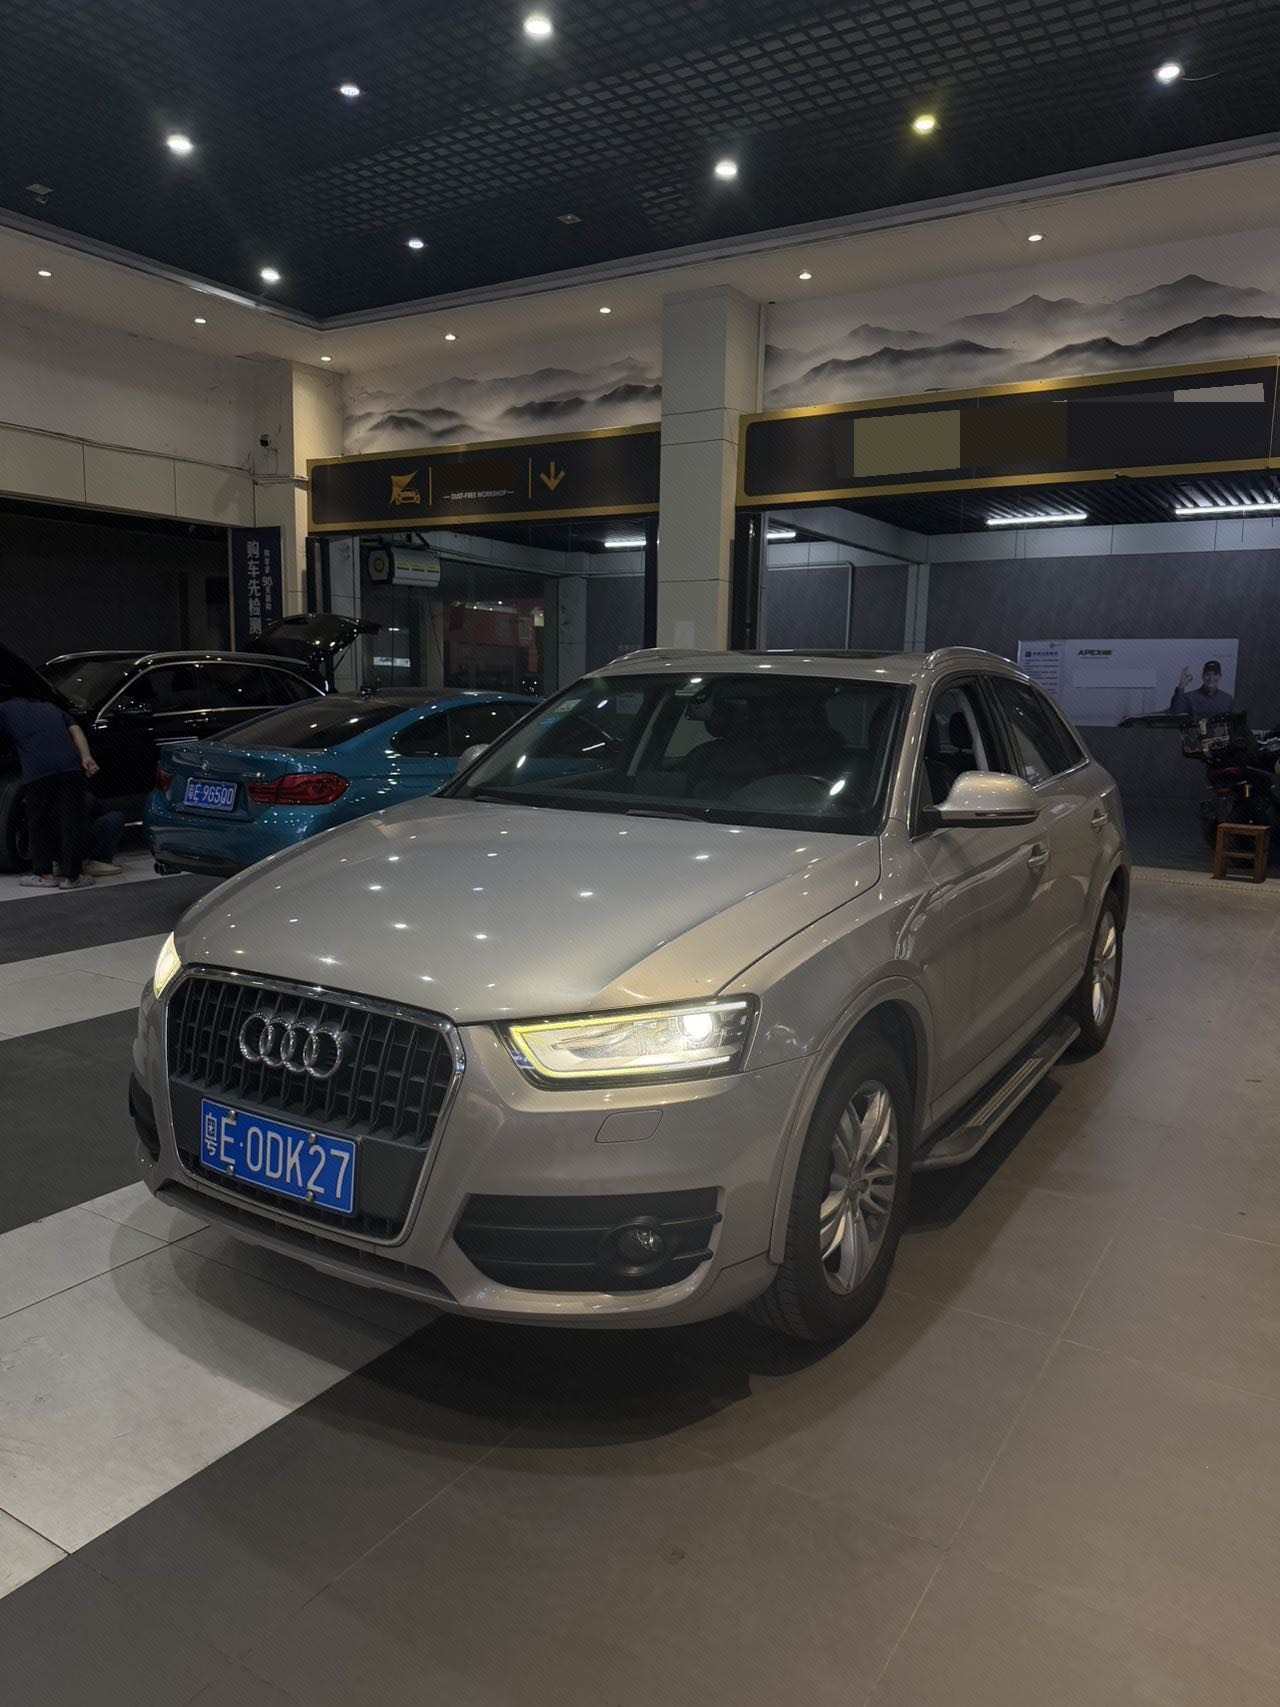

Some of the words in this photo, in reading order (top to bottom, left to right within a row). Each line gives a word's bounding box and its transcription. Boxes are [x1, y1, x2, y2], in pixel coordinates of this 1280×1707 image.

[477, 489, 507, 498] WORKSHOP
[247, 540, 262, 635] 购车先检测
